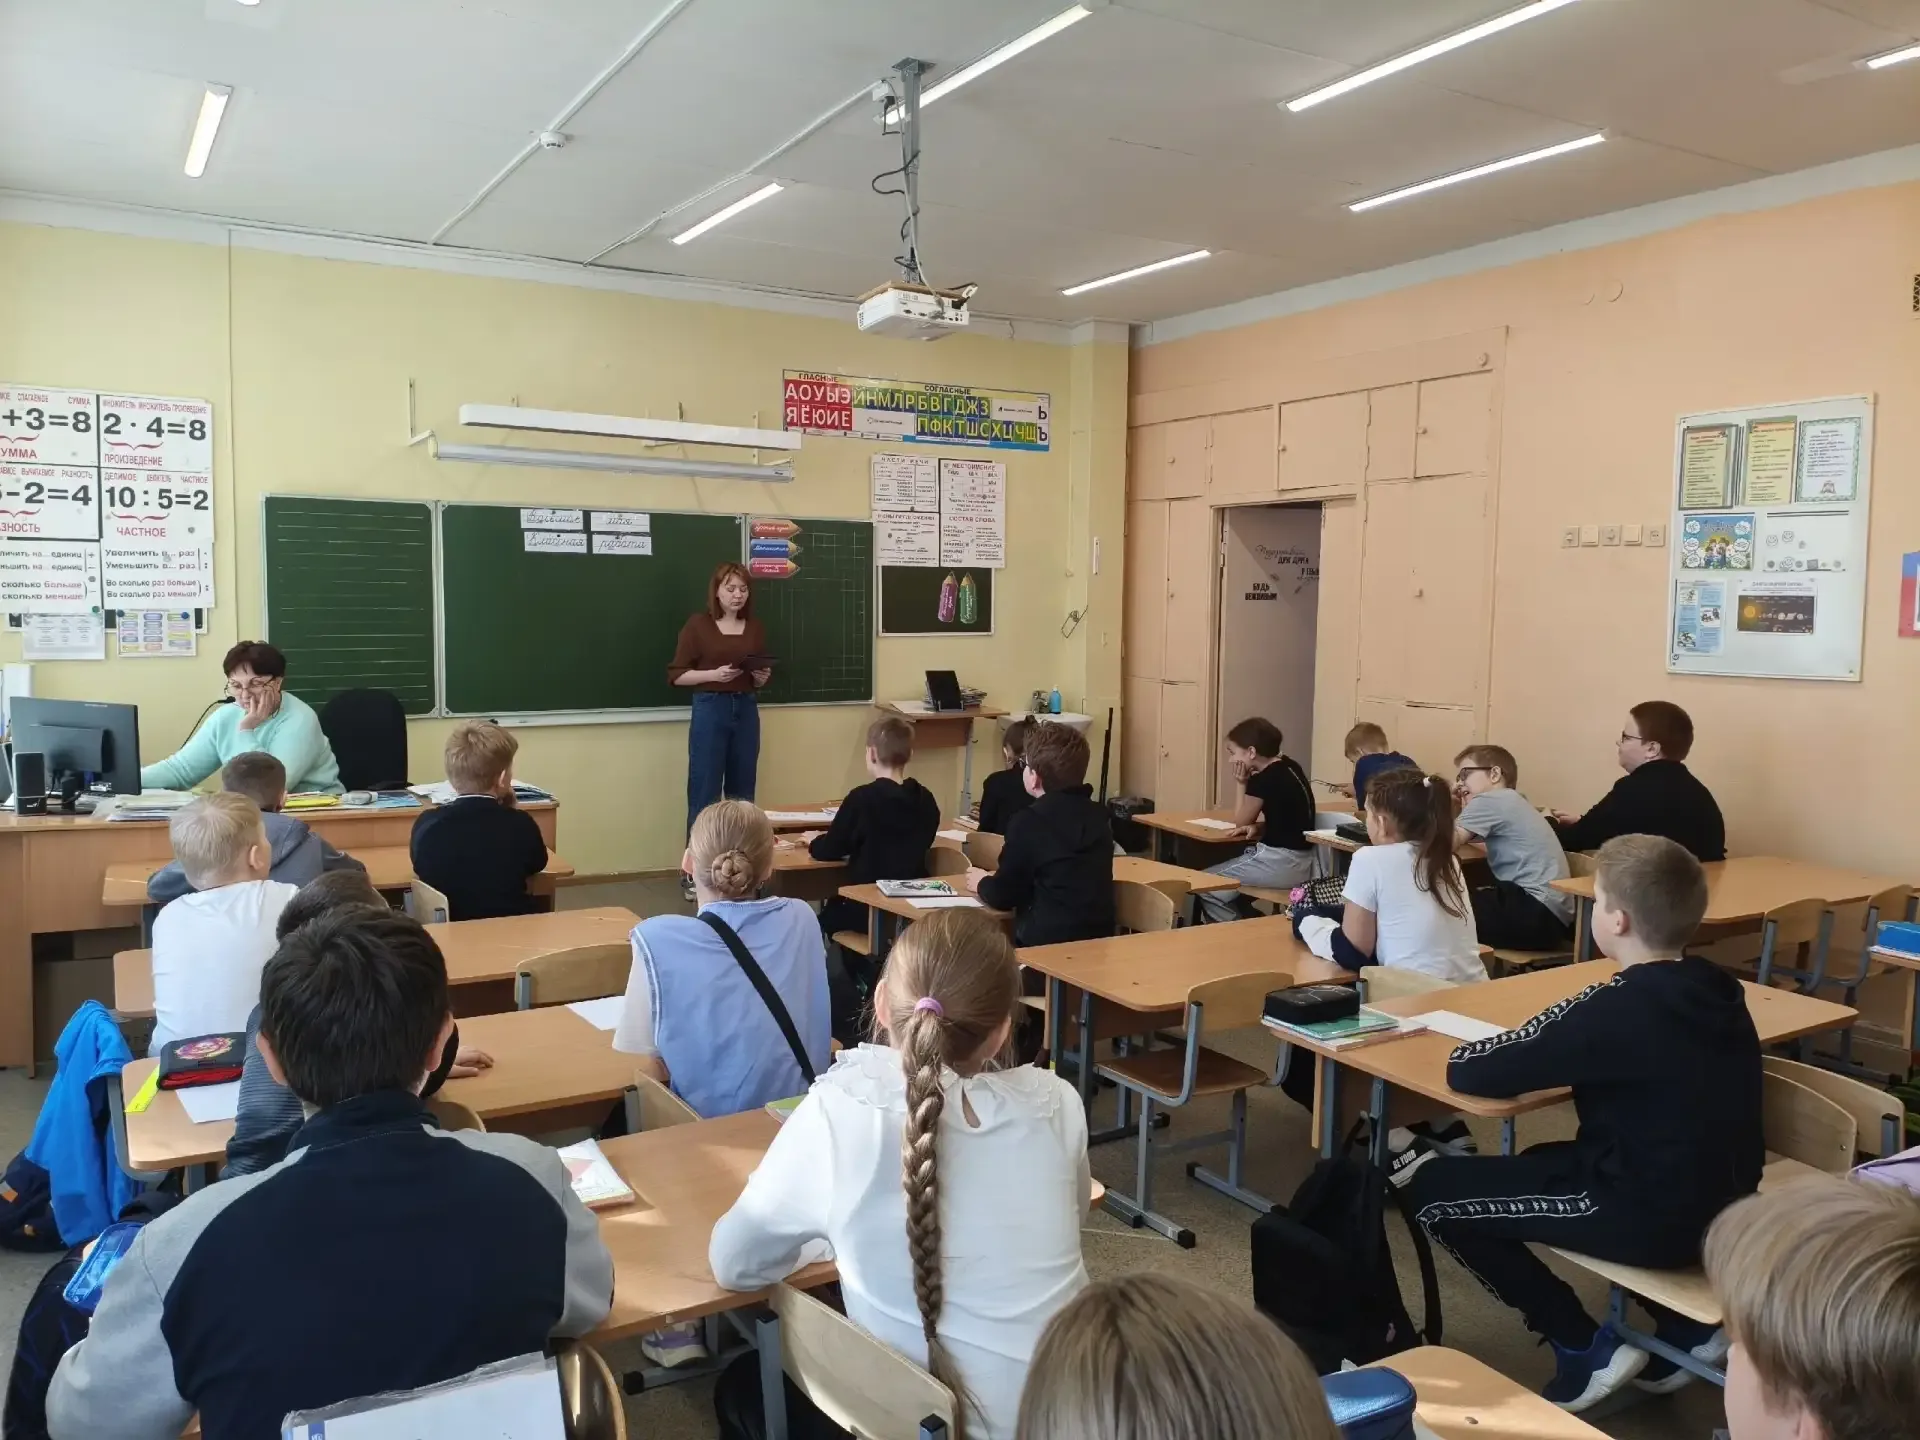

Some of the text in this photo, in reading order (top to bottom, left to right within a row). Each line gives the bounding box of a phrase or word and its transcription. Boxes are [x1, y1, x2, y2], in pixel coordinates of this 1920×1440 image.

[799, 373, 838, 382] ГЛАСНЫЕ
[924, 385, 971, 395] СОГЛАСНЫЕ
[104, 453, 163, 467] ПРОИЗВЕДЕНИЕ
[104, 472, 137, 481] ДЕЛИМОЕ
[180, 476, 208, 484] ЧАСТНОЕ
[0, 523, 40, 532] ЗНОСТЬ
[117, 527, 166, 537] ЧАСТНОЕ
[105, 549, 159, 557] Увеличить
[178, 550, 195, 558] раз
[44, 580, 82, 588] больше
[167, 579, 197, 587] больше
[1253, 582, 1270, 592] БУДЬ
[1392, 1158, 1401, 1170] BE
